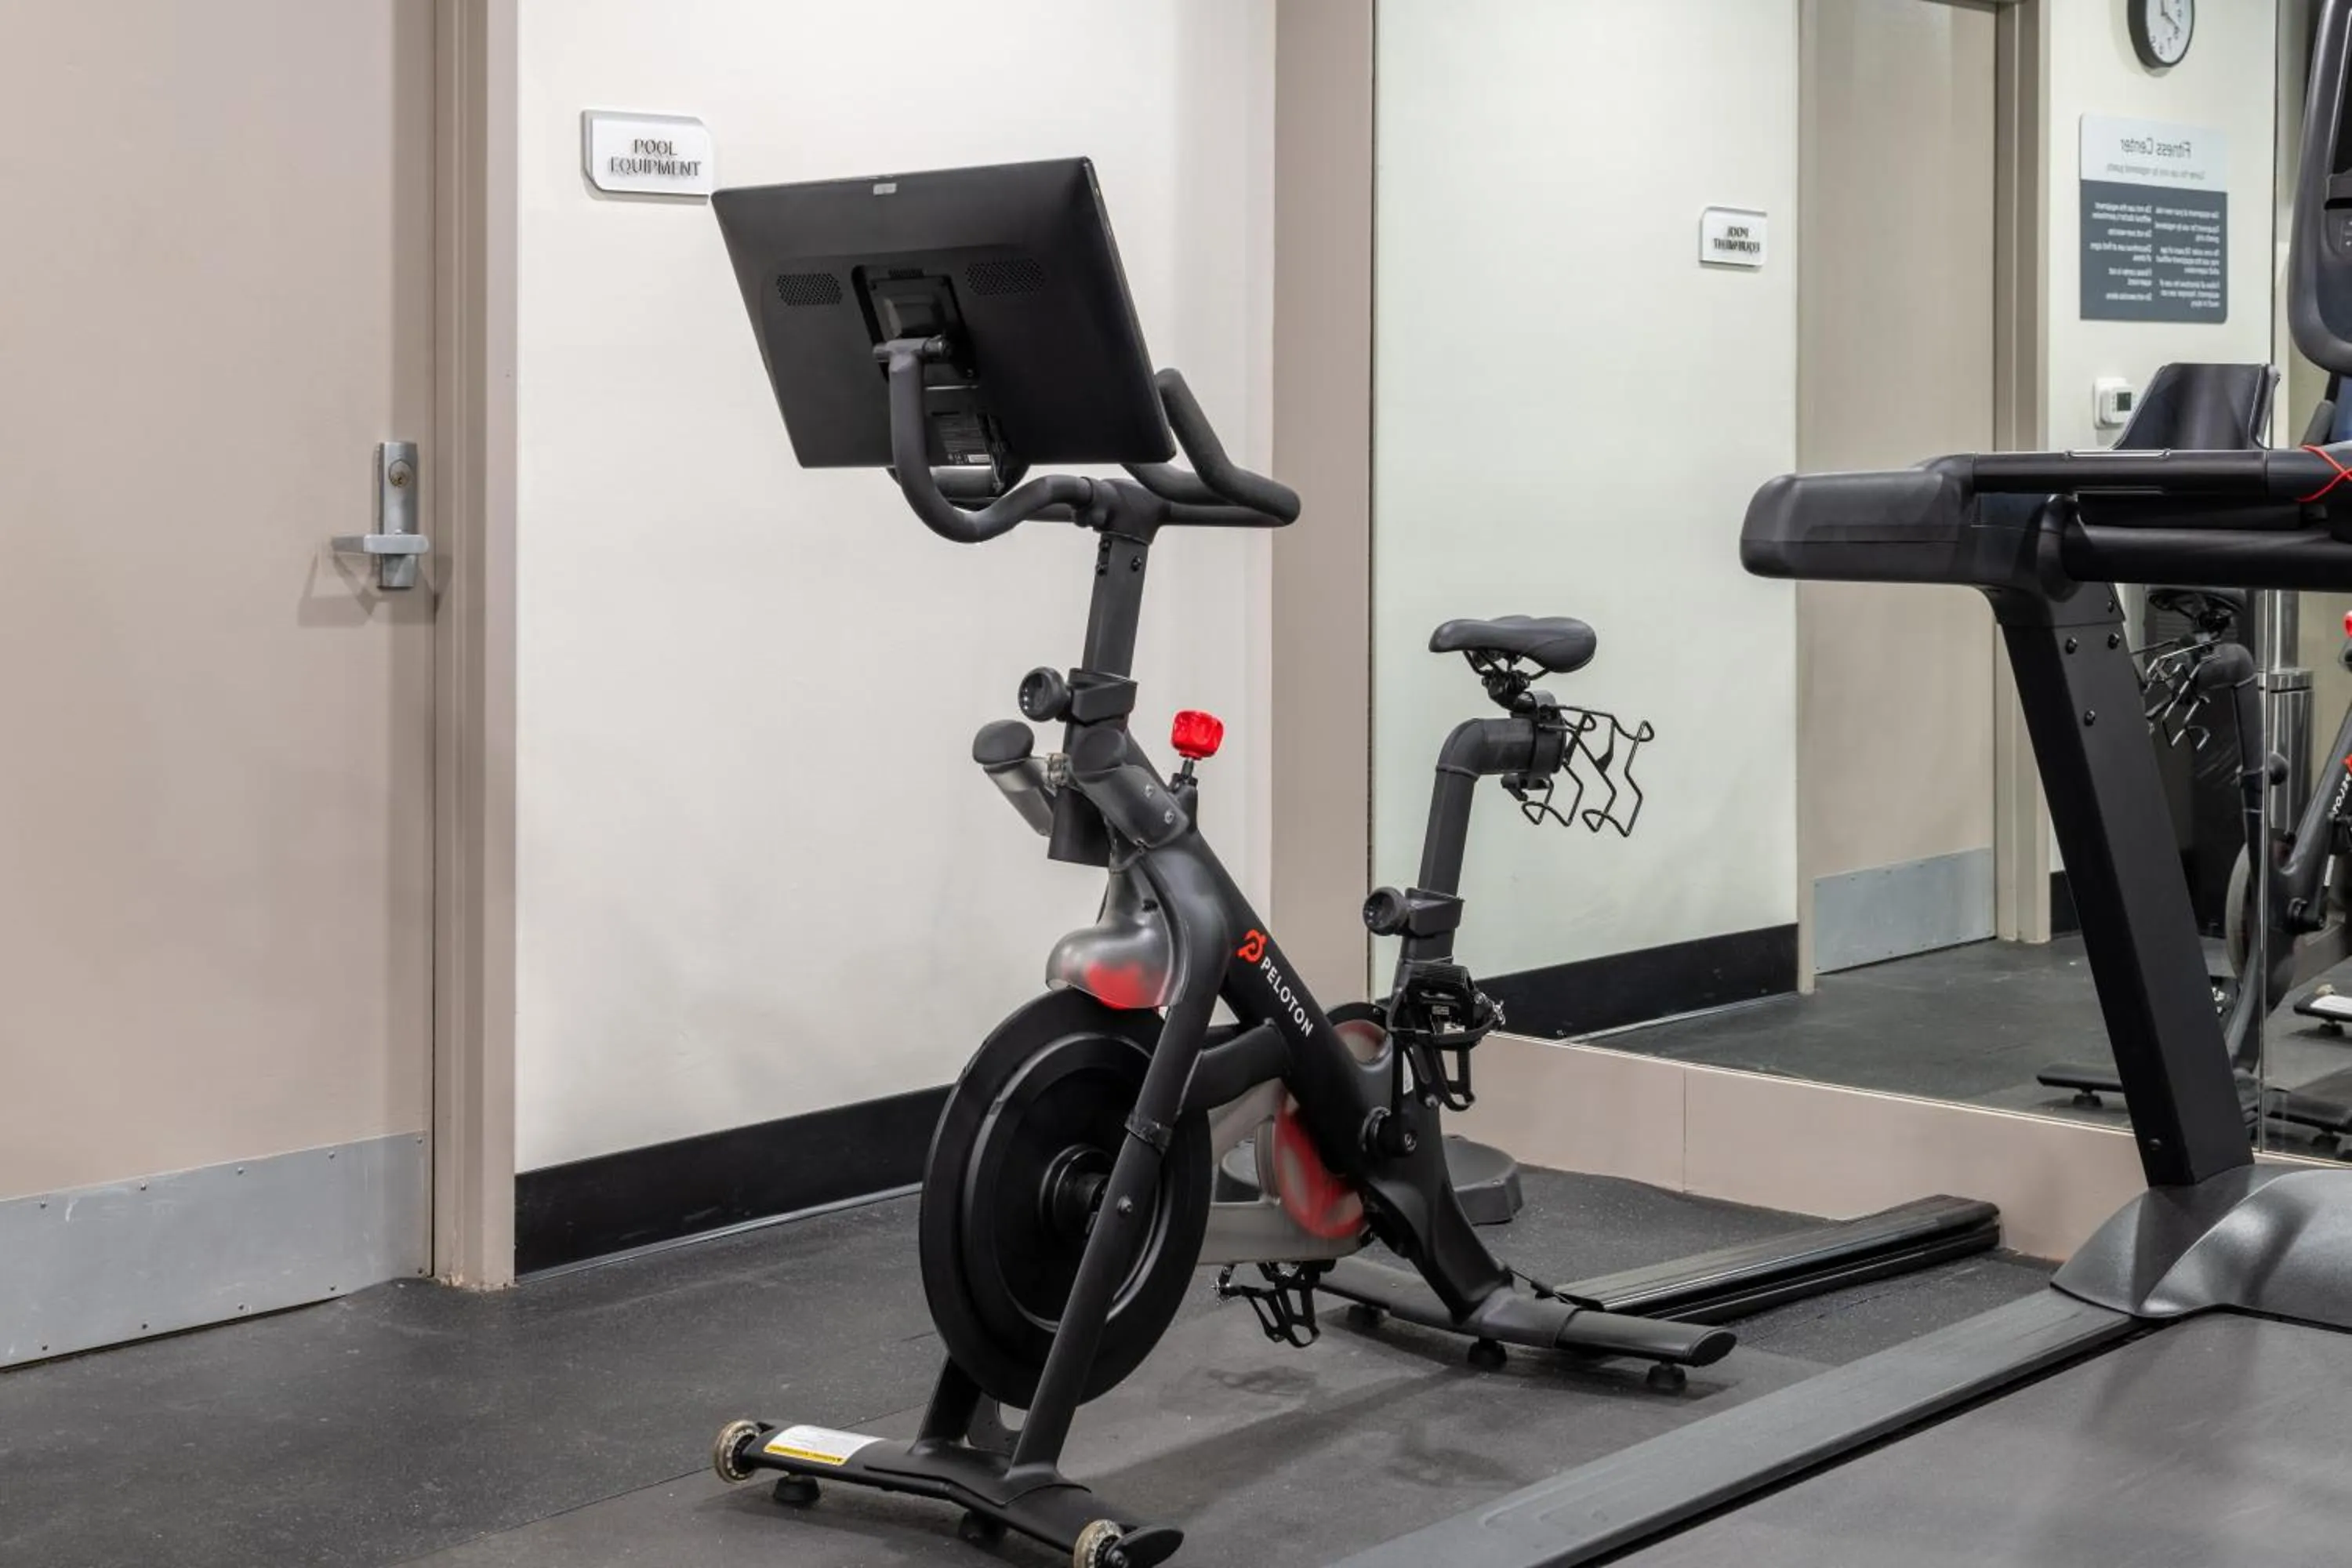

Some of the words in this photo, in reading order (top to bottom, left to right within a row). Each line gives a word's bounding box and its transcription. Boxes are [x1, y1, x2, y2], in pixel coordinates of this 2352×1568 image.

[634, 138, 677, 156] POOL
[610, 156, 702, 177] EQUIPMENT
[1260, 956, 1314, 1037] PELOTON
